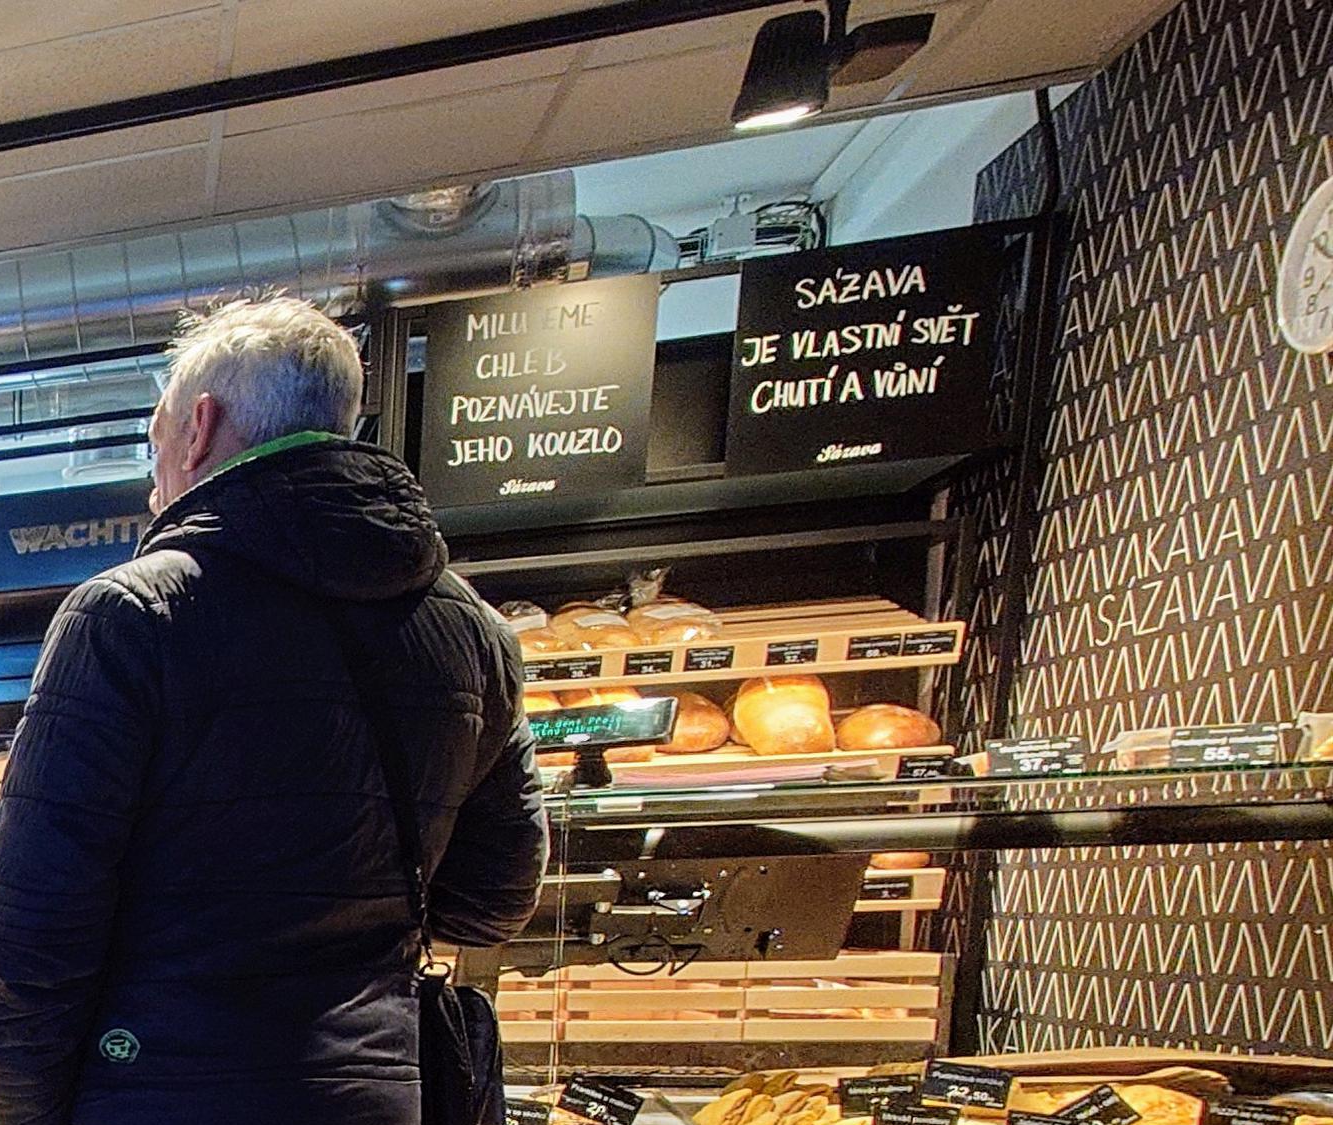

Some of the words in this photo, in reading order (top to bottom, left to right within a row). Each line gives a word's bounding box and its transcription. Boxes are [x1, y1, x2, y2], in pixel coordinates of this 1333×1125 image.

[794, 264, 927, 309] SÁZAVA
[741, 334, 781, 367] JE
[792, 309, 907, 360] VLASTNÍ
[911, 304, 981, 346] SVĚT
[451, 384, 621, 425] POZNÁVEJTE
[751, 364, 839, 414] CHUTÍ
[838, 371, 865, 404] A
[873, 355, 946, 398] VŮNÍ
[448, 436, 513, 466] JEHO
[527, 426, 623, 458] KOUZLO
[815, 443, 882, 462] Sázava
[499, 478, 558, 495] Sázava
